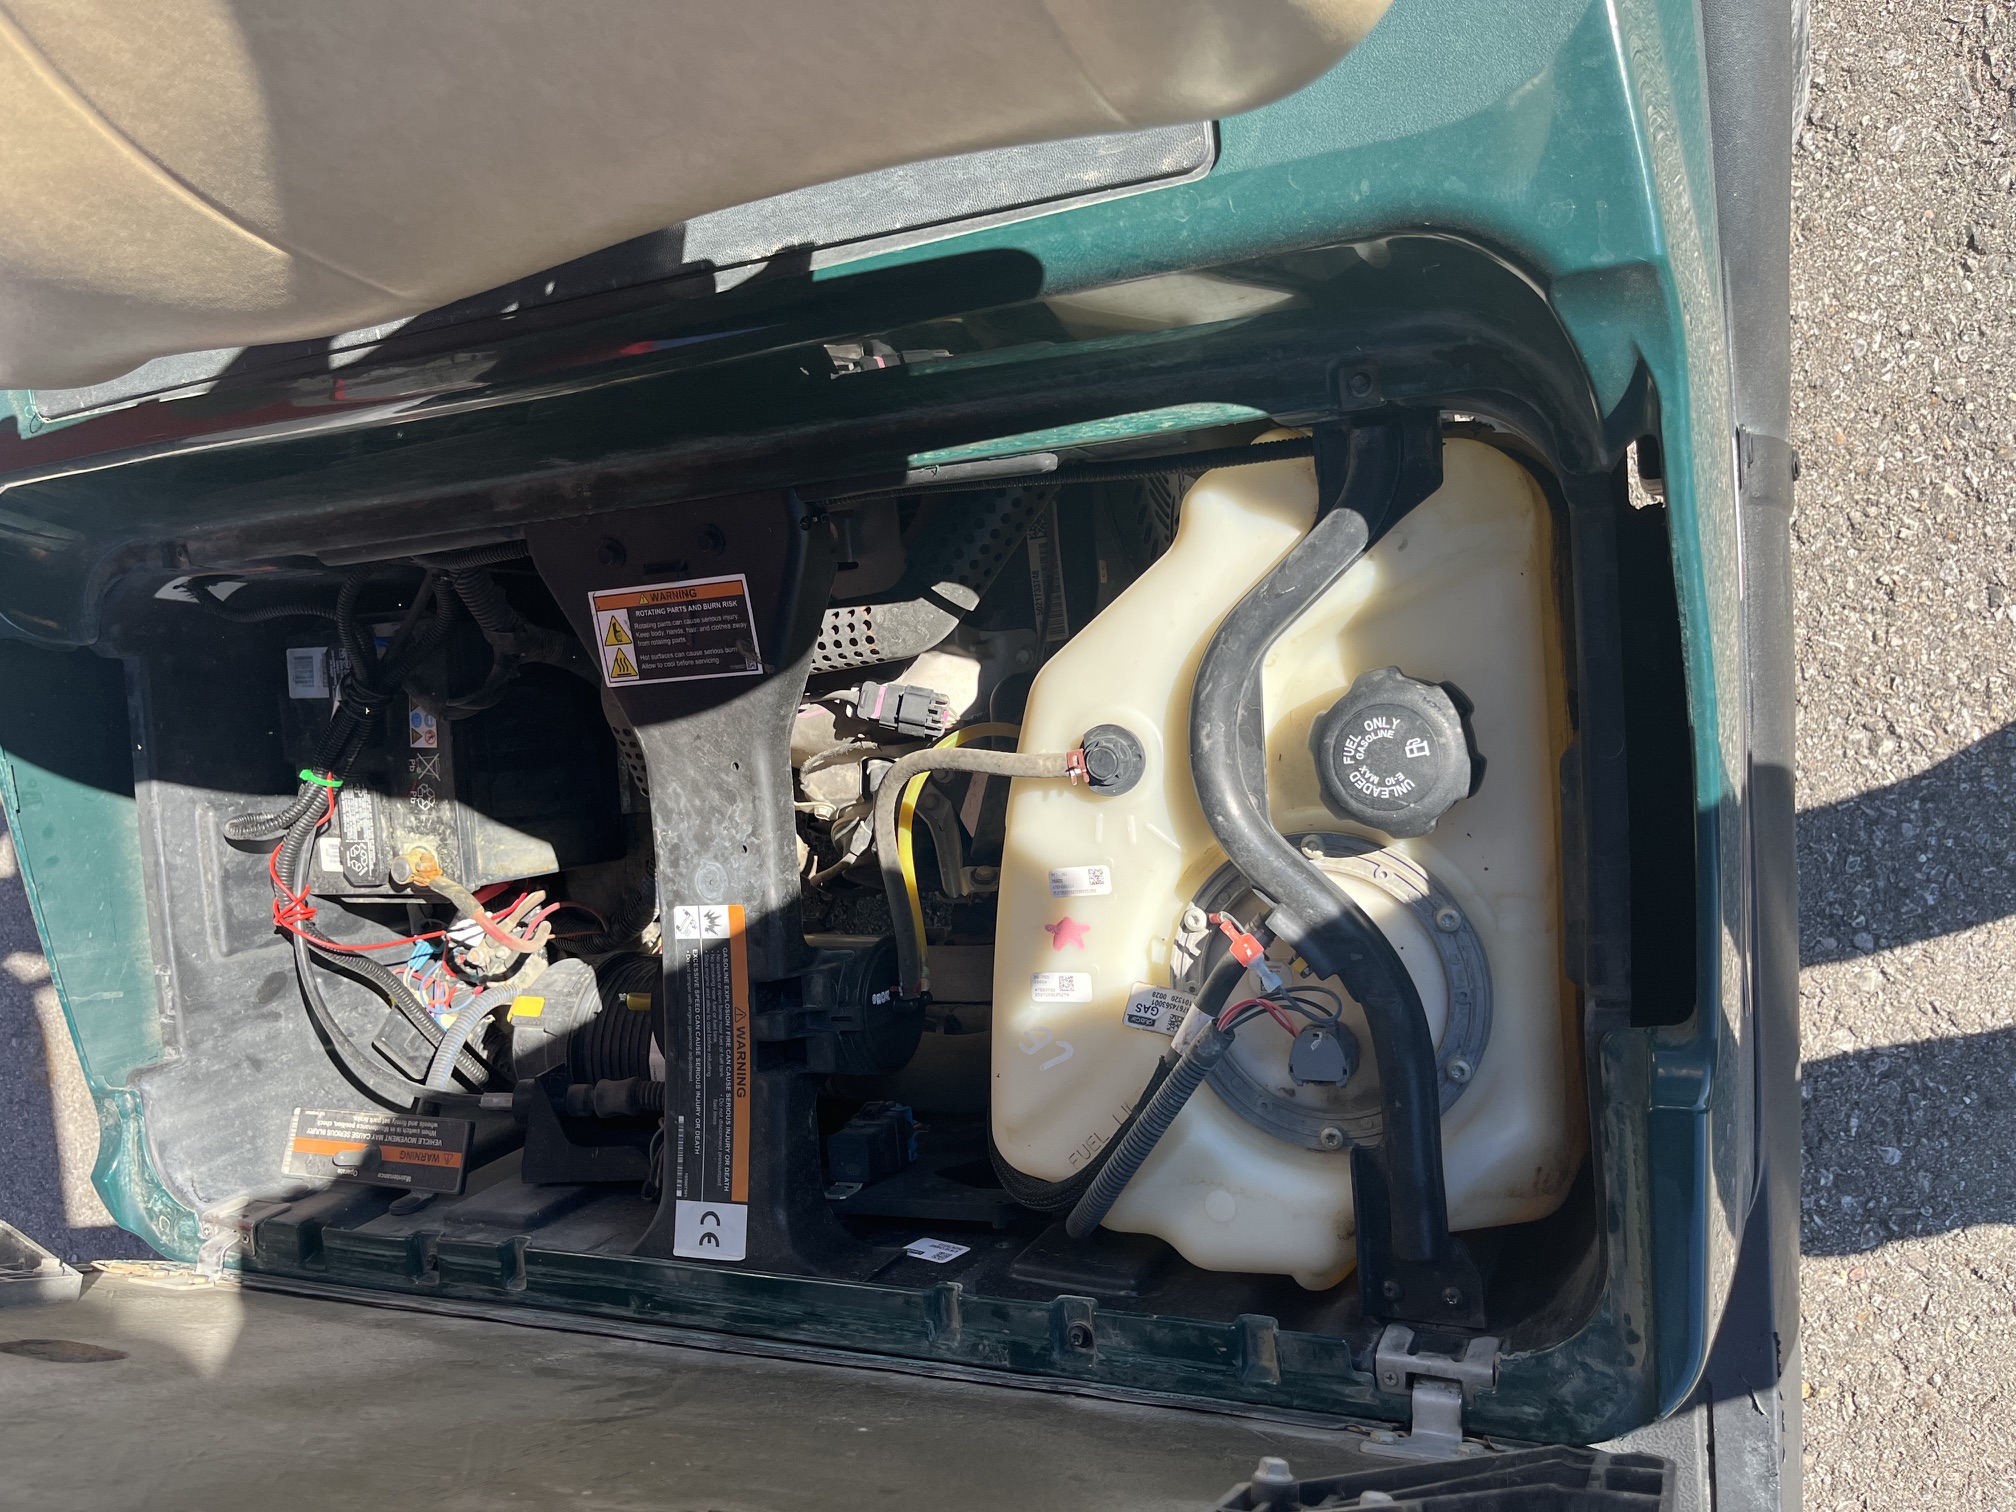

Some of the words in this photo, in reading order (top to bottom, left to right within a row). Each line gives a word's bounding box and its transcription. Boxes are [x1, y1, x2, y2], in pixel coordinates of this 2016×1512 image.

[650, 588, 697, 602] WARNING
[1031, 570, 1044, 616] 5021733748
[635, 608, 666, 617] ROTATING
[666, 605, 687, 614] PARTS
[687, 603, 702, 611] AND
[703, 601, 721, 610] BURN
[722, 599, 738, 608] RISK
[634, 622, 657, 631] Rotating
[701, 615, 722, 623] serious
[666, 628, 685, 636] hands,
[711, 623, 731, 631] clothes
[732, 622, 748, 630] away
[651, 638, 671, 647] rotating
[651, 652, 674, 660] surfaces
[703, 647, 724, 655] serious
[1364, 717, 1401, 732] ONLY
[1343, 735, 1361, 765] FUEL
[1356, 730, 1394, 760] GASOLINE
[409, 759, 415, 771] Pb
[1358, 765, 1379, 784] MAX
[1385, 772, 1406, 786] E-10
[1349, 771, 1415, 798] UNLEADED
[410, 791, 417, 803] Pb
[686, 954, 690, 962] Do
[710, 954, 715, 962] No
[716, 954, 720, 962] No
[1152, 991, 1167, 999] 0028
[1135, 1003, 1159, 1016] GAS
[737, 1027, 746, 1098] WARNING
[719, 1098, 723, 1107] Do
[369, 1116, 382, 1124] park
[391, 1118, 407, 1126] firmly
[419, 1121, 438, 1129] wheels
[695, 1118, 700, 1129] OR
[306, 1127, 327, 1136] INJURY
[356, 1123, 389, 1132] Maintenance
[402, 1127, 421, 1135] switch
[326, 1129, 351, 1138] SERIOUS
[351, 1132, 372, 1140] CAUSE
[384, 1134, 418, 1144] MOVEMENT
[417, 1137, 443, 1146] VEHICLE
[399, 1150, 440, 1163] WARNING
[1069, 1132, 1110, 1170] FUEL
[725, 1155, 730, 1165] OR
[336, 1167, 358, 1177] Operate
[377, 1172, 412, 1182] Maintenance
[699, 1211, 721, 1248] CE
